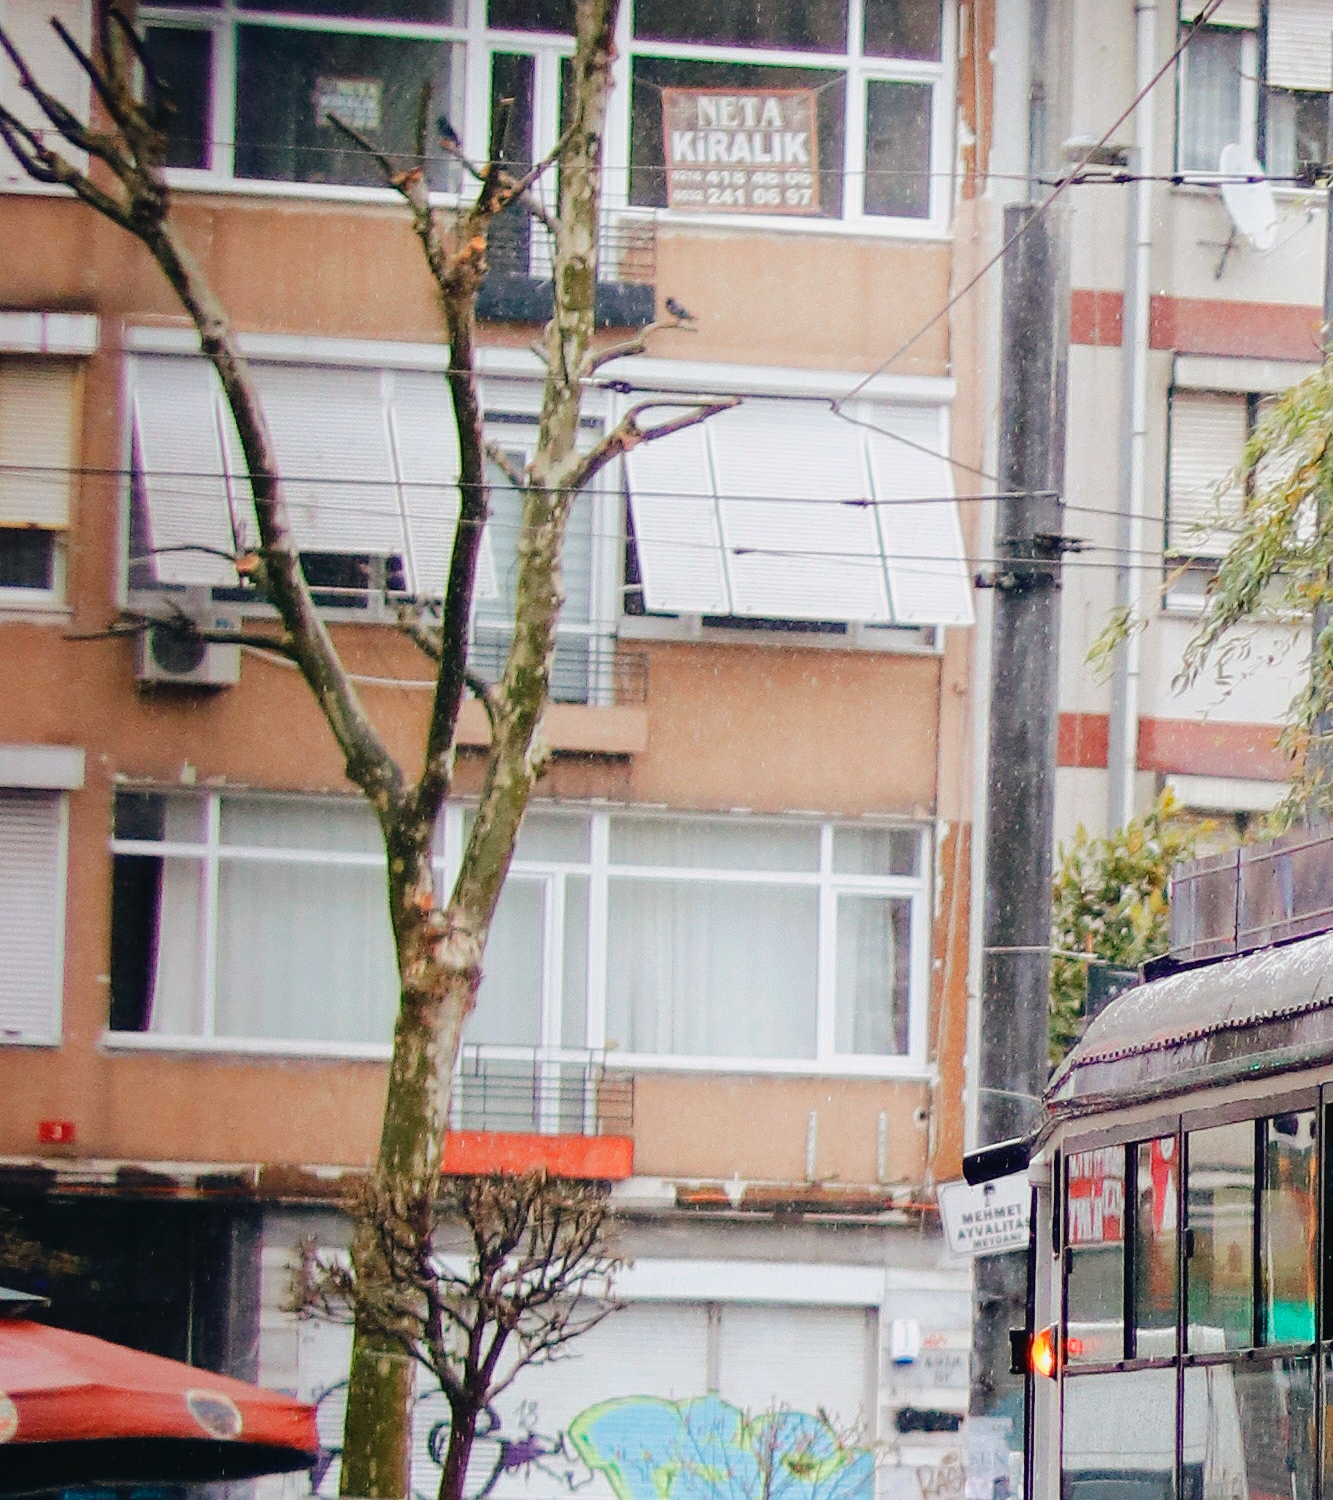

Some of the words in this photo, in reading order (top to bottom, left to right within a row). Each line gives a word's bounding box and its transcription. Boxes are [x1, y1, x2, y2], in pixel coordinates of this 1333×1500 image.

[696, 96, 784, 127] NETA
[706, 187, 747, 205] 241
[962, 1203, 1022, 1223] MEHMET
